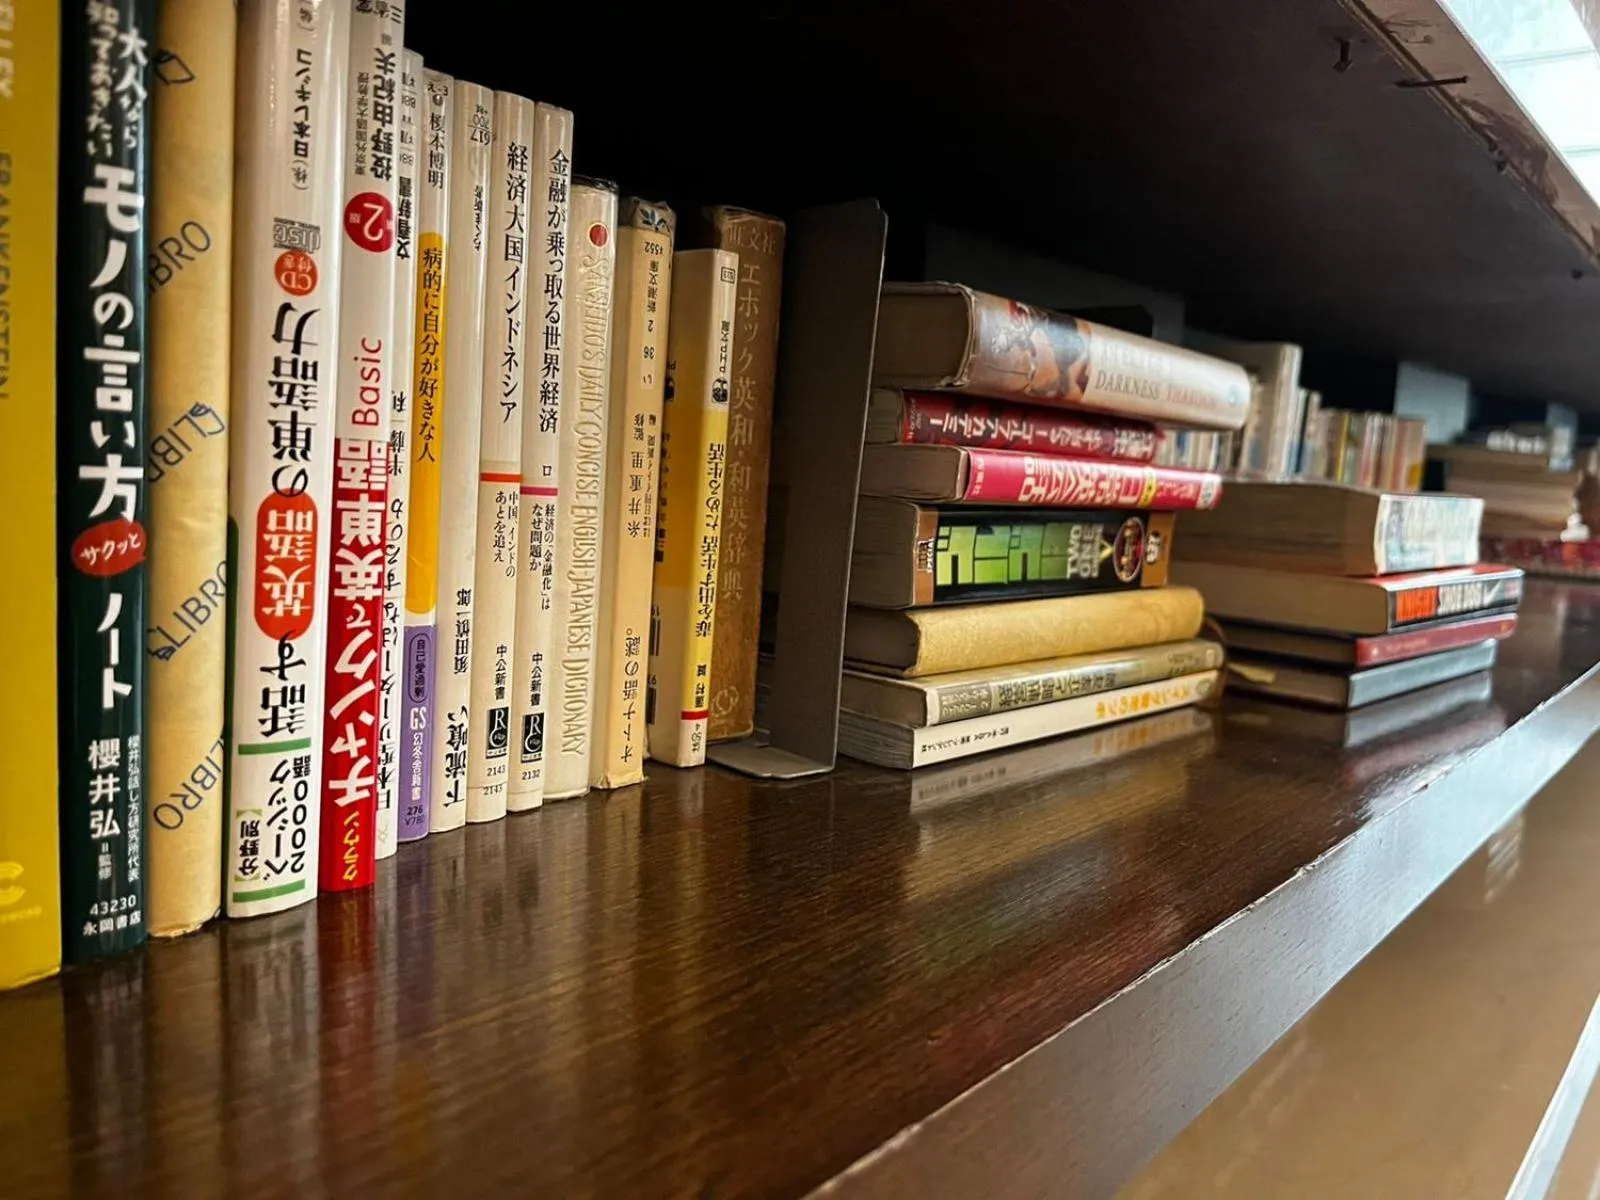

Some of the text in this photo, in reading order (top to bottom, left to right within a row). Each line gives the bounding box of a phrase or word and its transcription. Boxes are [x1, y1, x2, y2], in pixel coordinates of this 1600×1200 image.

[428, 112, 446, 190] 榎本博明
[469, 130, 491, 146] 617
[280, 270, 313, 291] CD
[499, 141, 529, 424] 経済大国インドネシア
[538, 147, 570, 434] 金融が乗っ取る世界経済
[351, 337, 383, 427] Basic
[417, 247, 442, 463] 病的に自分が好きな人
[577, 366, 607, 420] DAILY
[574, 421, 603, 501] CONCISE
[627, 451, 644, 539] 糸井重里
[79, 532, 143, 566] サクッと
[492, 491, 507, 563] あとを追え
[528, 504, 543, 572] なぜ問題か
[97, 592, 133, 710] ノート
[453, 588, 472, 675] 須田慎一郎
[495, 643, 508, 701] 中公新書
[530, 652, 543, 707] 中公新書
[561, 658, 590, 757] DICTIONARY
[409, 706, 427, 730] GS
[443, 705, 469, 808] 下流喰い
[264, 759, 291, 882] ベーシック
[342, 810, 361, 881] クラウン
[82, 910, 142, 937] 永岡書店
[89, 894, 137, 916] 43230
